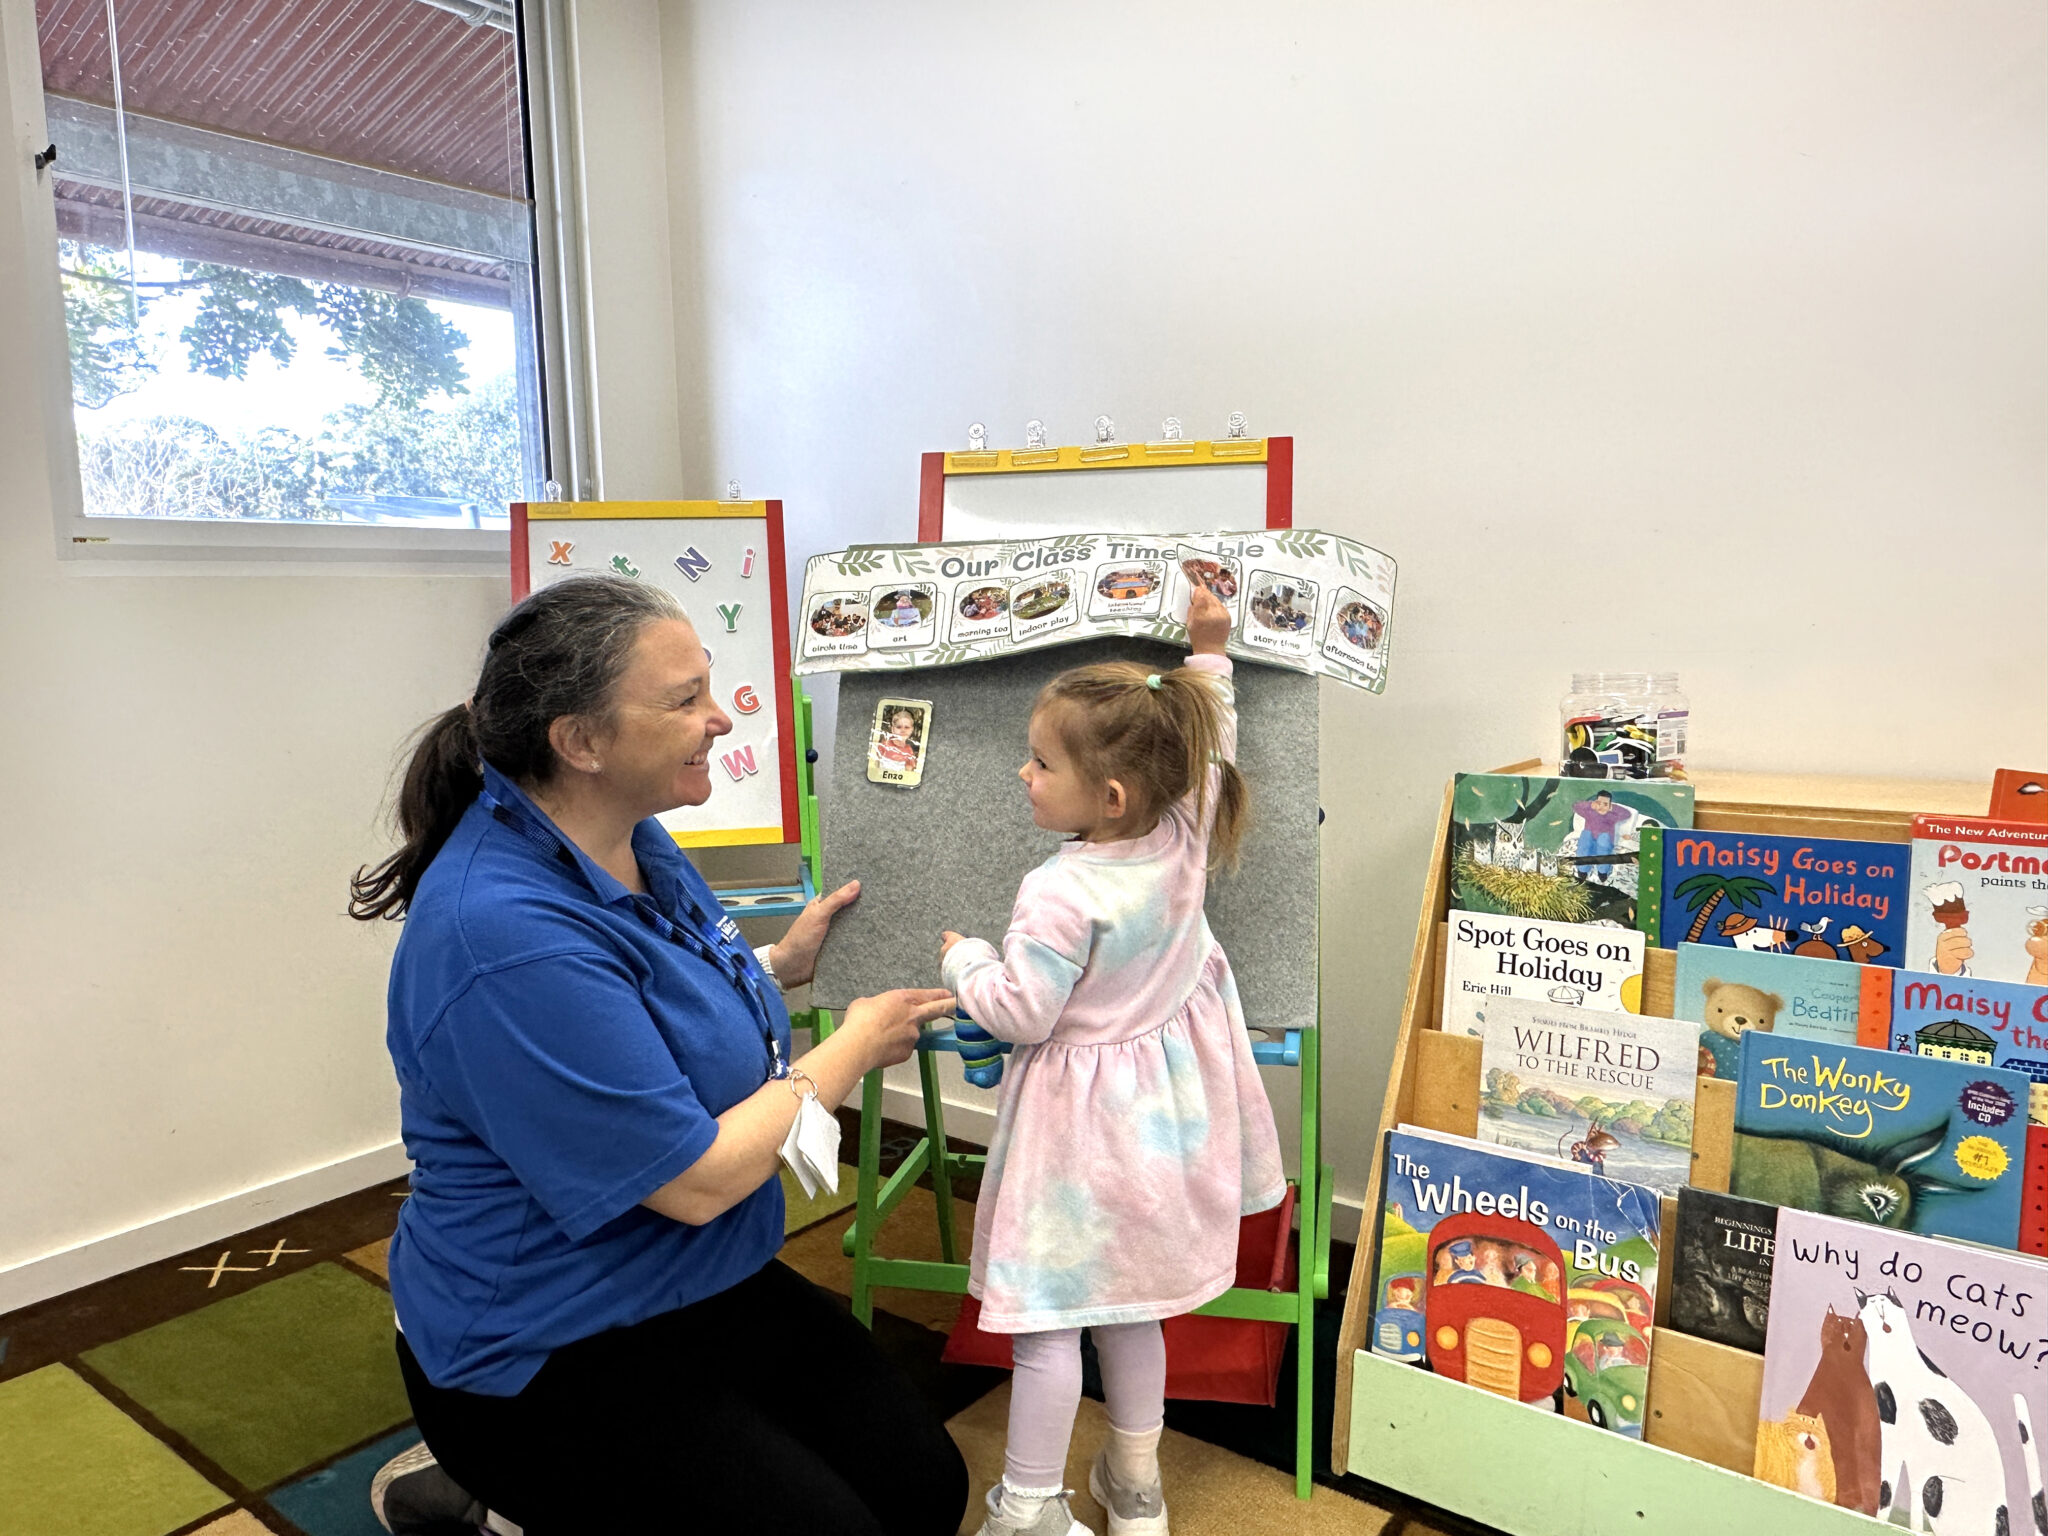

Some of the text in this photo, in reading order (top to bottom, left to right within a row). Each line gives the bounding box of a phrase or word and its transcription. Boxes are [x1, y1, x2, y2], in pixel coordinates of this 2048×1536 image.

[676, 547, 710, 581] N
[742, 548, 755, 577] i
[941, 541, 1264, 578] Our Class Timeble
[718, 603, 743, 631] Y
[1050, 616, 1069, 627] play
[812, 643, 836, 652] circle
[893, 635, 907, 643] art
[958, 628, 991, 637] morning
[1253, 635, 1300, 650] story time
[1326, 644, 1378, 674] afternoon tea
[733, 685, 761, 713] G
[721, 745, 758, 780] W
[882, 770, 904, 781] Enzo
[1928, 823, 1951, 835] The
[1955, 825, 1984, 837] New
[1676, 838, 1895, 879] Maisy Goes on
[1938, 844, 2048, 875] Postm
[1783, 873, 1889, 920] Holiday
[1981, 876, 2027, 888] paints
[1457, 919, 1632, 963] Spot Goes on
[1496, 951, 1603, 992] Holiday
[1463, 980, 1512, 996] Eric Hill
[1904, 982, 2011, 1031] Maisy
[1514, 1026, 1660, 1072] WILFRED
[1516, 1053, 1654, 1090] TO THE RESCUE
[1761, 1055, 1911, 1111] The Wonky
[1760, 1083, 1873, 1138] Donkey
[1967, 1100, 2006, 1117] Includes
[1978, 1112, 1991, 1123] CD
[1394, 1153, 1430, 1180] The
[1411, 1176, 1617, 1245] Wheels on the
[1723, 1229, 1776, 1257] LIFE
[1573, 1238, 1640, 1283] Bus
[1880, 1251, 1922, 1283] do
